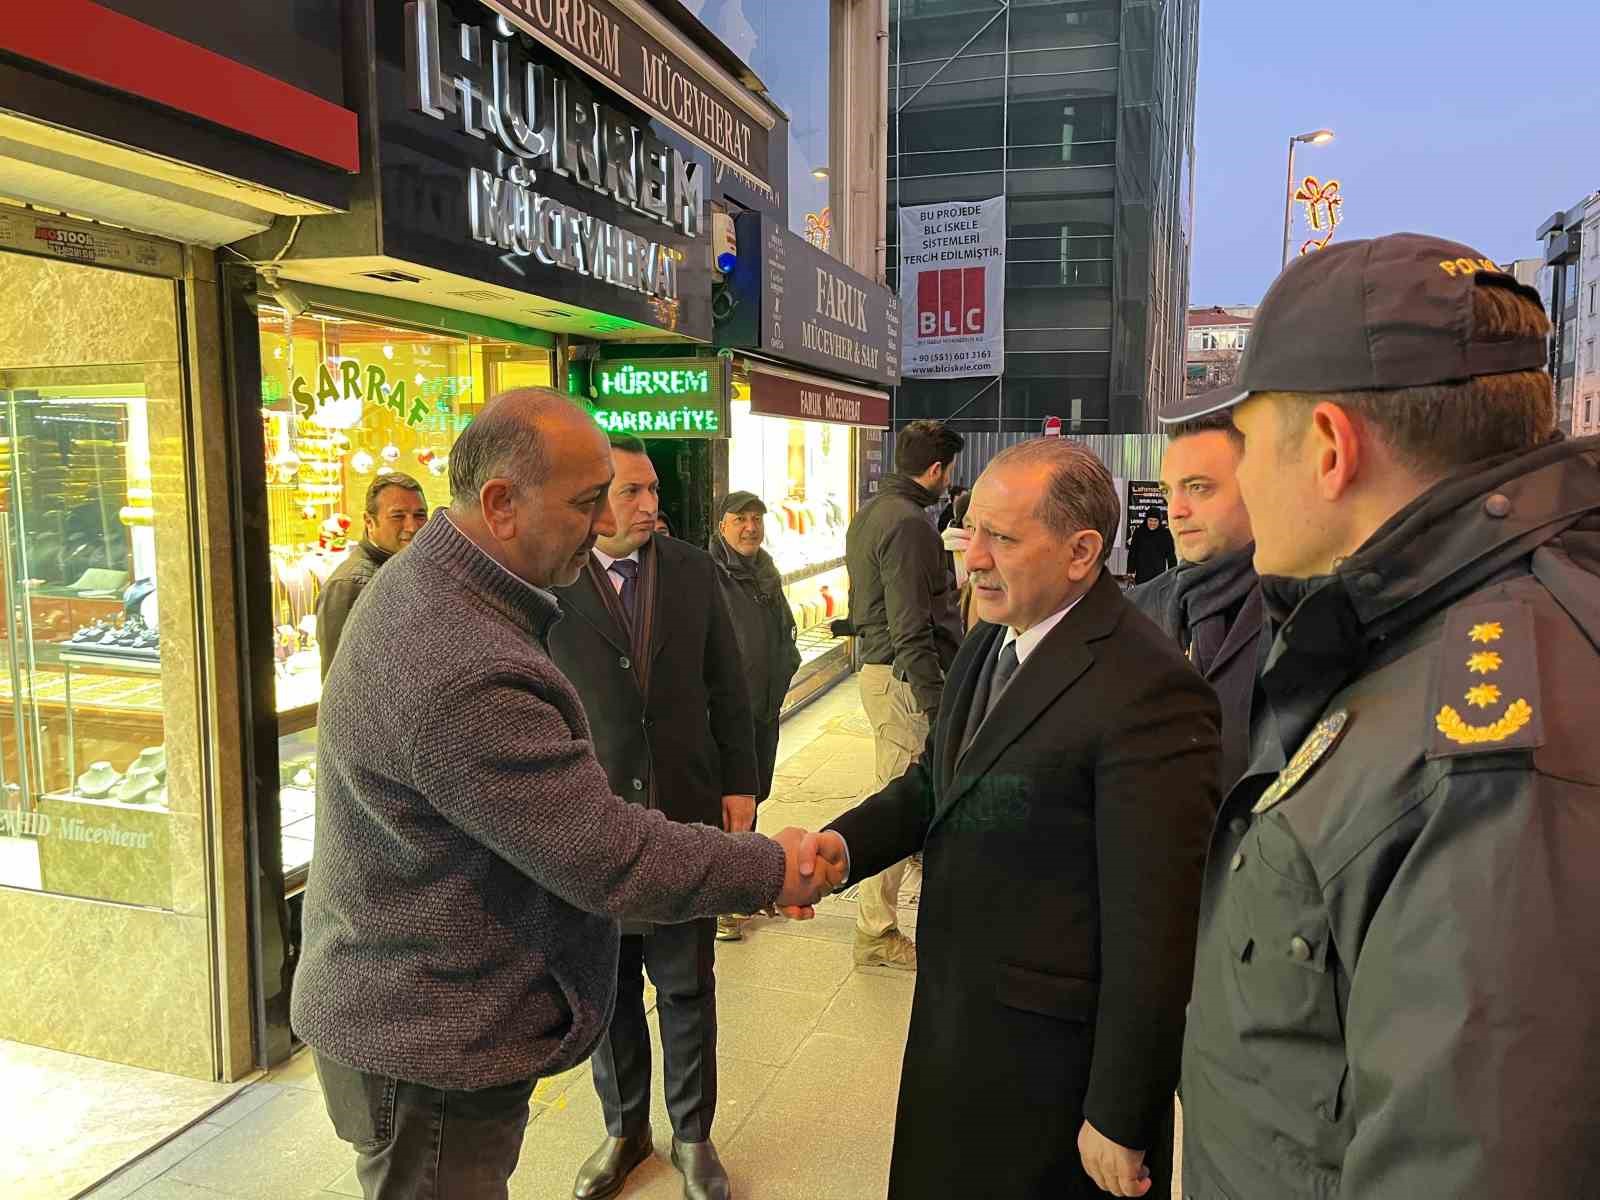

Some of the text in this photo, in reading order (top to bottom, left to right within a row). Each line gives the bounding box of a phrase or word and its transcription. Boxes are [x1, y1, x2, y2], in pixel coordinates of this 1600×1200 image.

[641, 46, 751, 167] MÜCEVHERAT
[920, 205, 981, 221] BU PROJEDE
[922, 232, 980, 249] SİSTEMLERİ
[924, 224, 942, 235] BLC
[816, 266, 868, 333] FARUK
[920, 308, 982, 336] BLC
[801, 318, 853, 362] MÜCEVHER
[861, 348, 879, 369] SAAT
[292, 360, 430, 426] SARRAF
[602, 365, 708, 395] HÜRREM
[800, 390, 822, 417] FARUK
[593, 406, 718, 432] SARRAFİYE
